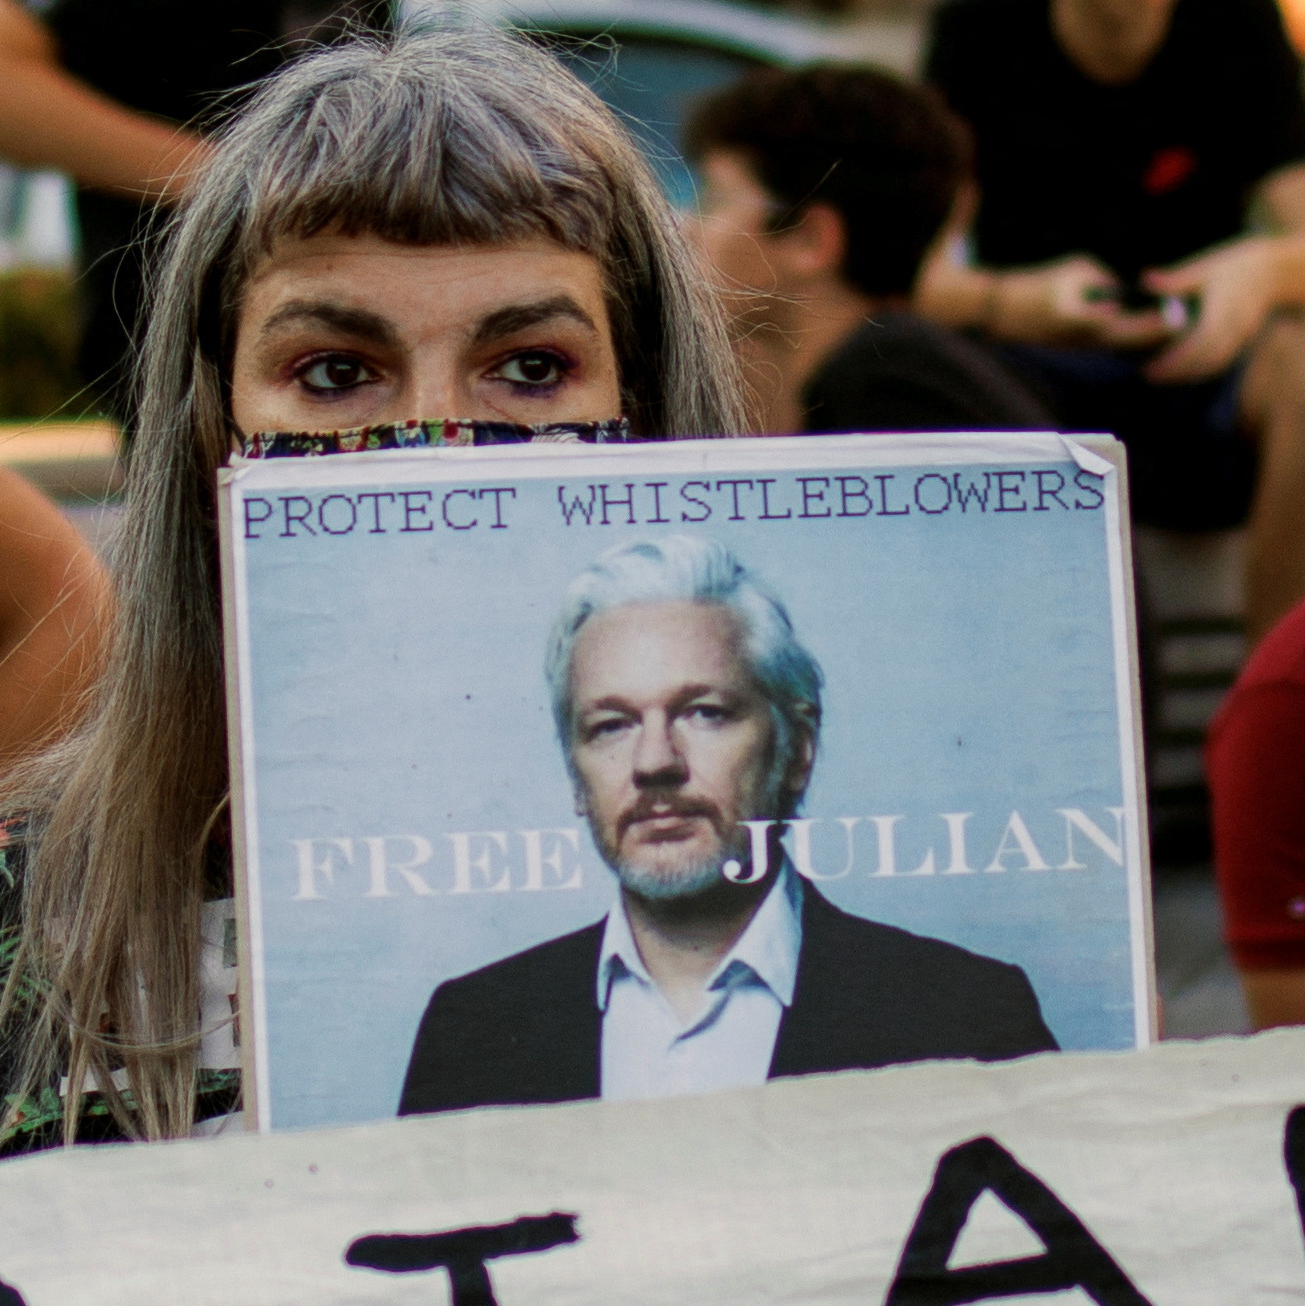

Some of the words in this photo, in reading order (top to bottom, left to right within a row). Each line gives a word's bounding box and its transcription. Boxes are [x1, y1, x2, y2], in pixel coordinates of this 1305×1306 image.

[243, 487, 516, 539] PROTECT
[558, 470, 1105, 526] WHISTLEBLOWERS
[290, 827, 584, 901] FREE
[721, 806, 1126, 884] JULIAN
